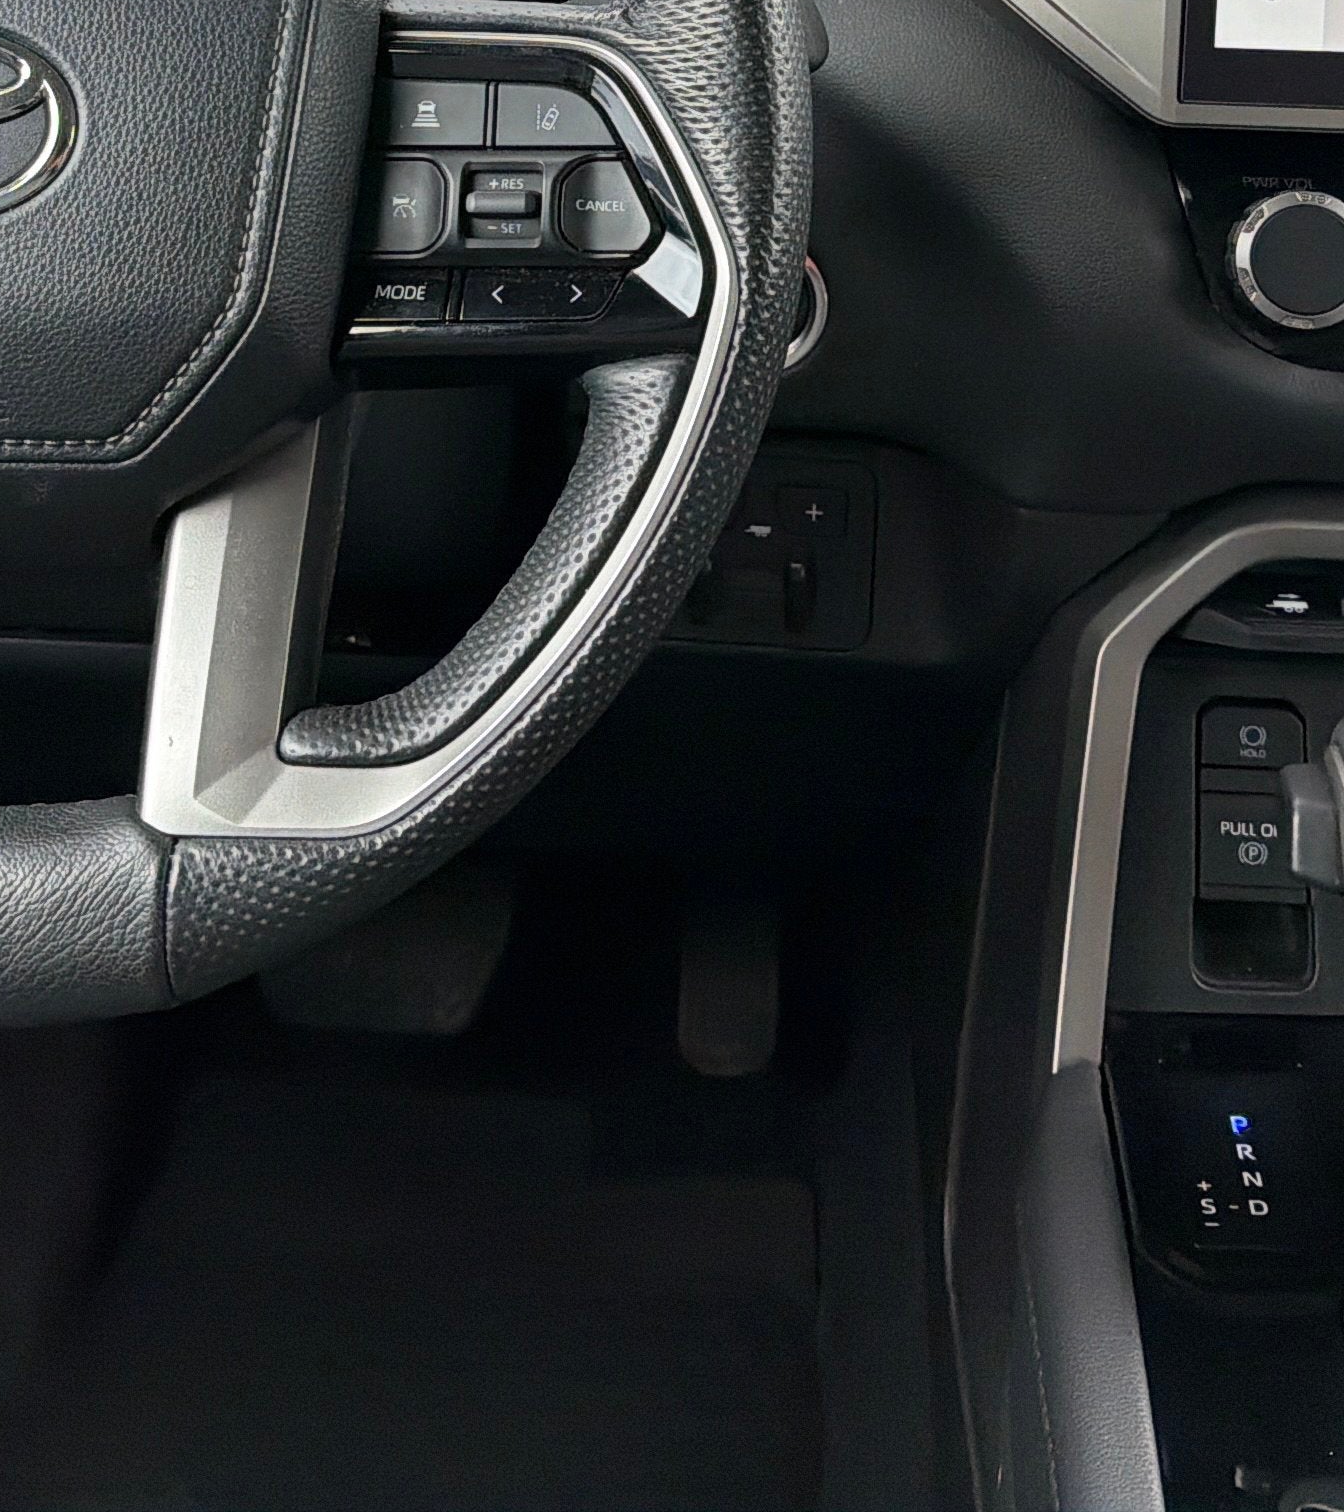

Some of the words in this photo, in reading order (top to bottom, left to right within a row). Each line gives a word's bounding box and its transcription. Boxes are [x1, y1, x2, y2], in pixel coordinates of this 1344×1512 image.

[576, 199, 625, 213] CANCEL
[375, 285, 427, 301] MODE
[1240, 748, 1267, 759] HOLD
[1220, 820, 1257, 837] PULL
[1229, 1115, 1251, 1136] P
[1235, 1143, 1257, 1161] R
[1241, 1170, 1264, 1188] N
[1200, 1197, 1217, 1215] S
[1248, 1198, 1270, 1216] D
